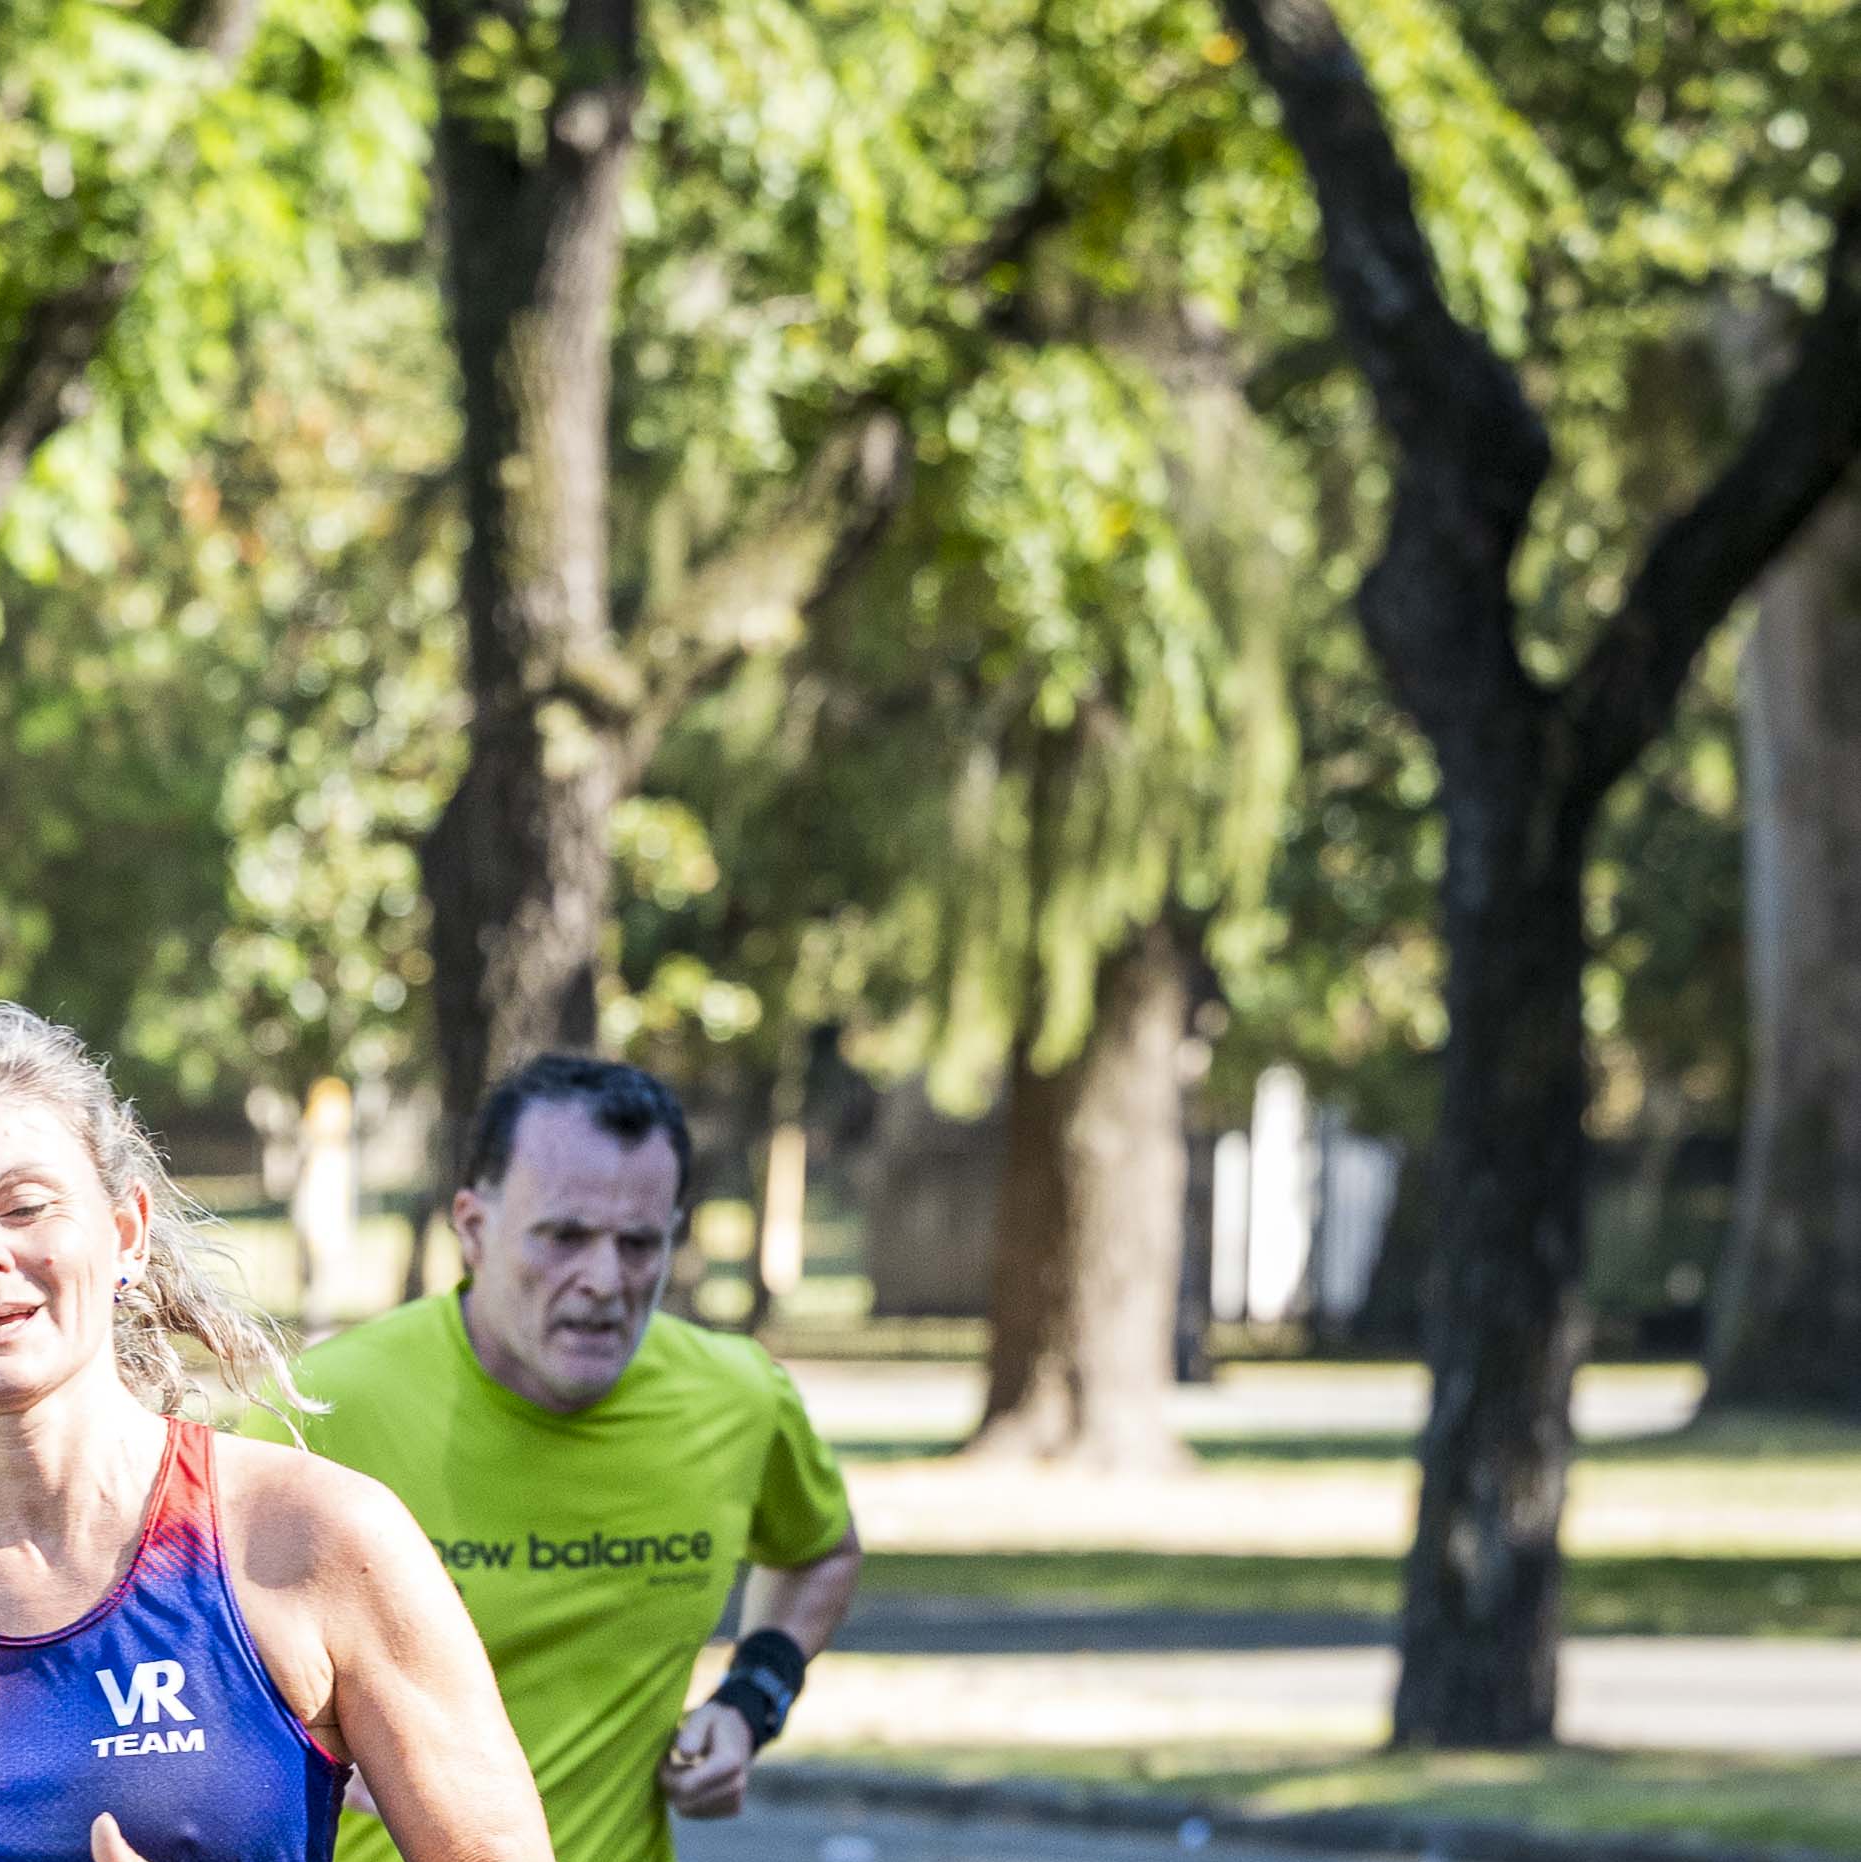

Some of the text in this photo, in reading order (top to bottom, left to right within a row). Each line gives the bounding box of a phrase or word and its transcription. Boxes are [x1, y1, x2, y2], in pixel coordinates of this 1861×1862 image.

[527, 1531, 712, 1570] balance
[95, 1659, 197, 1727] VR
[90, 1728, 205, 1758] TEAM
